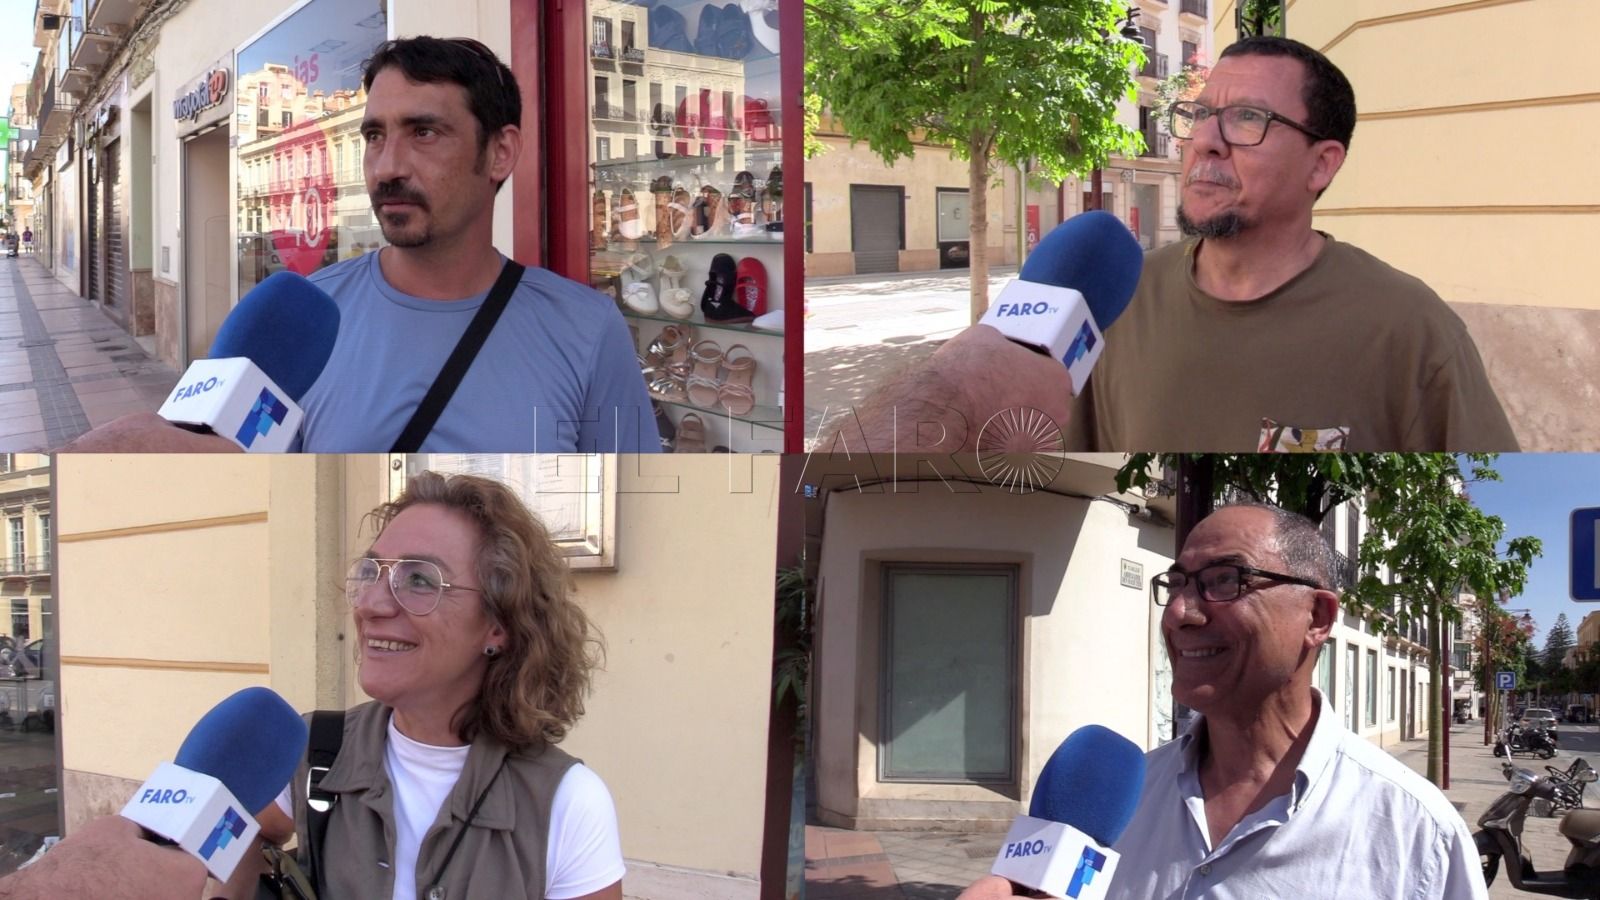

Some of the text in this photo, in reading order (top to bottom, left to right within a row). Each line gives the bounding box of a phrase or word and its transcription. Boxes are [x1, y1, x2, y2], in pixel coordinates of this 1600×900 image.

[997, 302, 1048, 317] FARO
[173, 377, 217, 402] FARO
[1500, 674, 1511, 688] P
[140, 789, 187, 804] FARO
[1005, 840, 1044, 858] FARO
